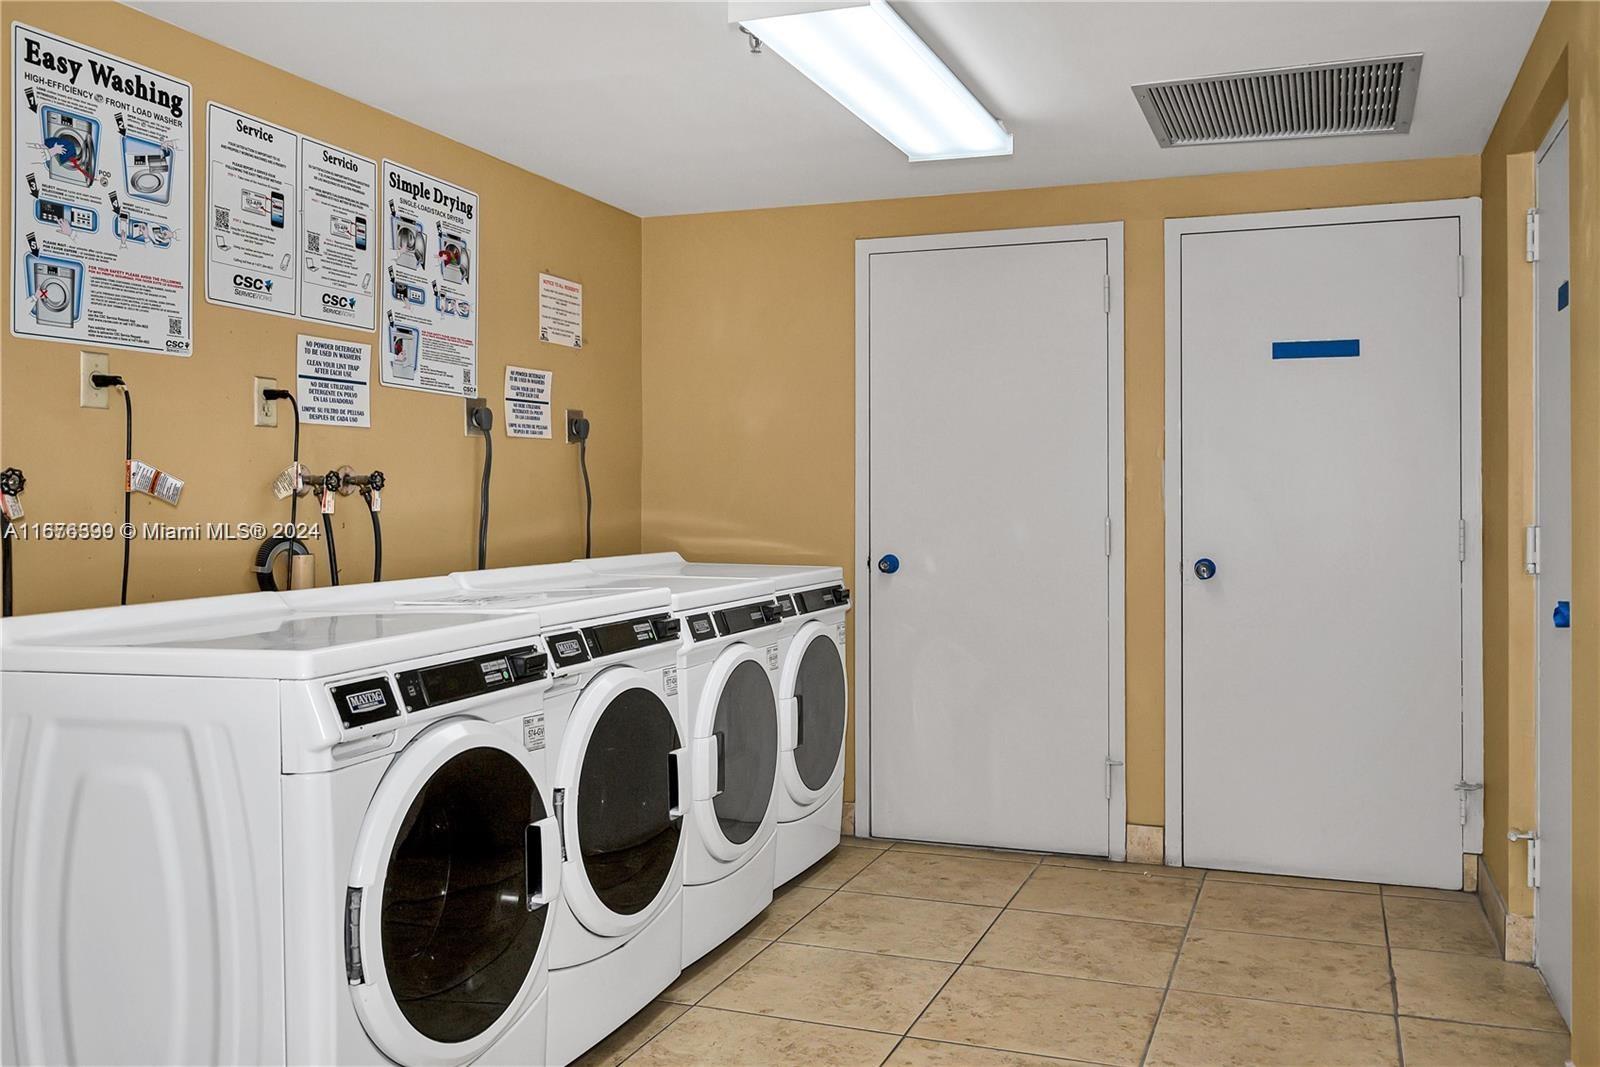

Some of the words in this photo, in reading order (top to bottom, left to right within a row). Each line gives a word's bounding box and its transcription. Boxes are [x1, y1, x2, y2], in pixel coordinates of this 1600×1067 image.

[24, 38, 82, 84] Easy
[88, 59, 183, 118] Washing
[25, 72, 93, 100] HIGH-EFFICIENCY
[106, 98, 130, 111] FRONT
[132, 106, 152, 119] LOAD
[154, 112, 183, 128] WASHER
[236, 119, 274, 143] Service
[323, 150, 358, 172] Servicio
[389, 171, 430, 201] Simple
[433, 187, 473, 220] Drying
[447, 213, 464, 224] DRYERS
[233, 274, 264, 291] CSC
[322, 293, 348, 308] CSC
[165, 340, 184, 348] CSC
[314, 341, 334, 350] POWDER
[335, 344, 362, 354] DETERGENT
[340, 353, 361, 361] WASHERS
[309, 388, 335, 396] DETERGENTE
[350, 691, 382, 705] MAYTAG
